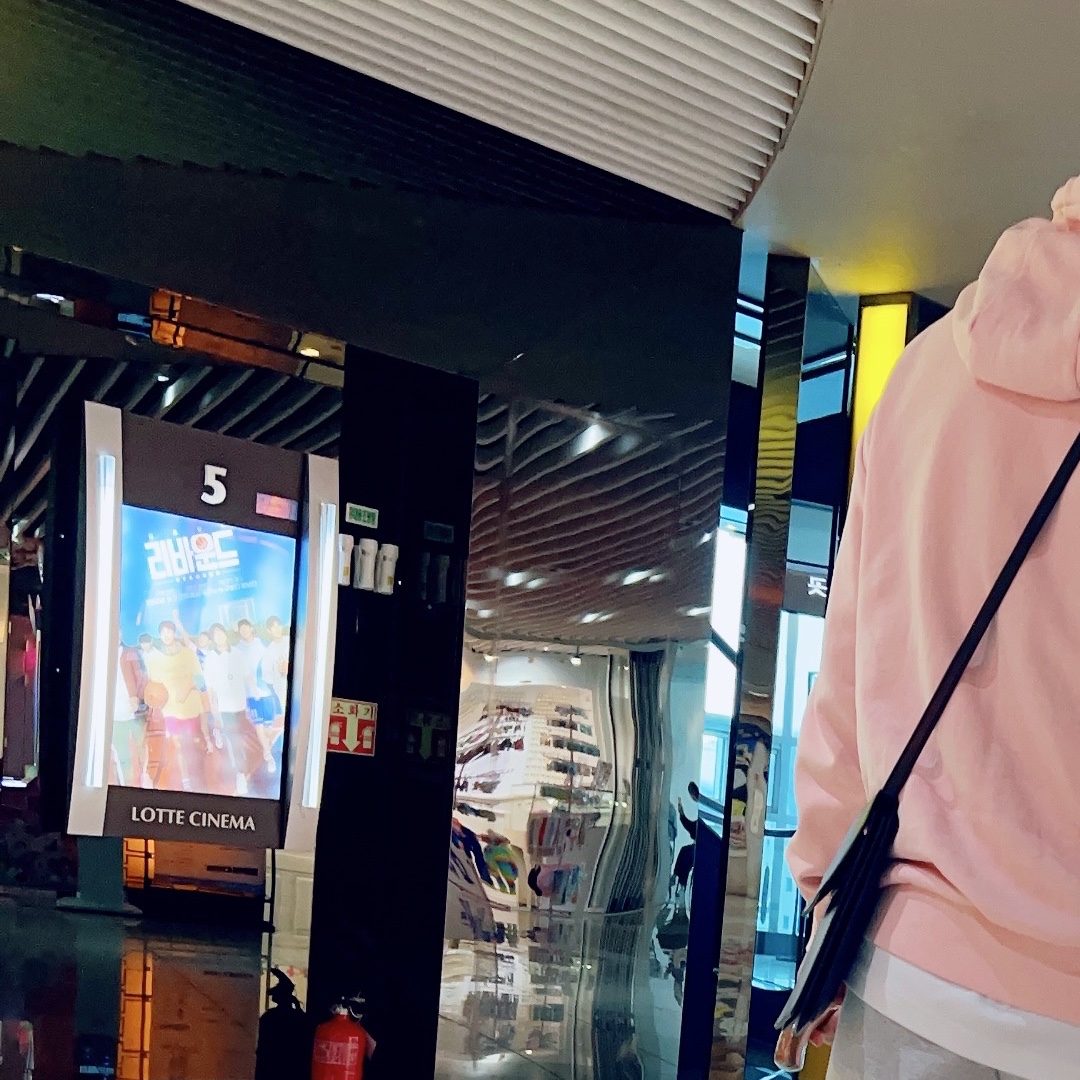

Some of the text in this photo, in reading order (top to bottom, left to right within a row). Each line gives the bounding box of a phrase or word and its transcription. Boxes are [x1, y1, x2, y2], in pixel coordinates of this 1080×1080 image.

[200, 464, 227, 505] 5
[144, 528, 240, 581] 리바운드
[131, 806, 256, 831] LOTTE CINEMA
